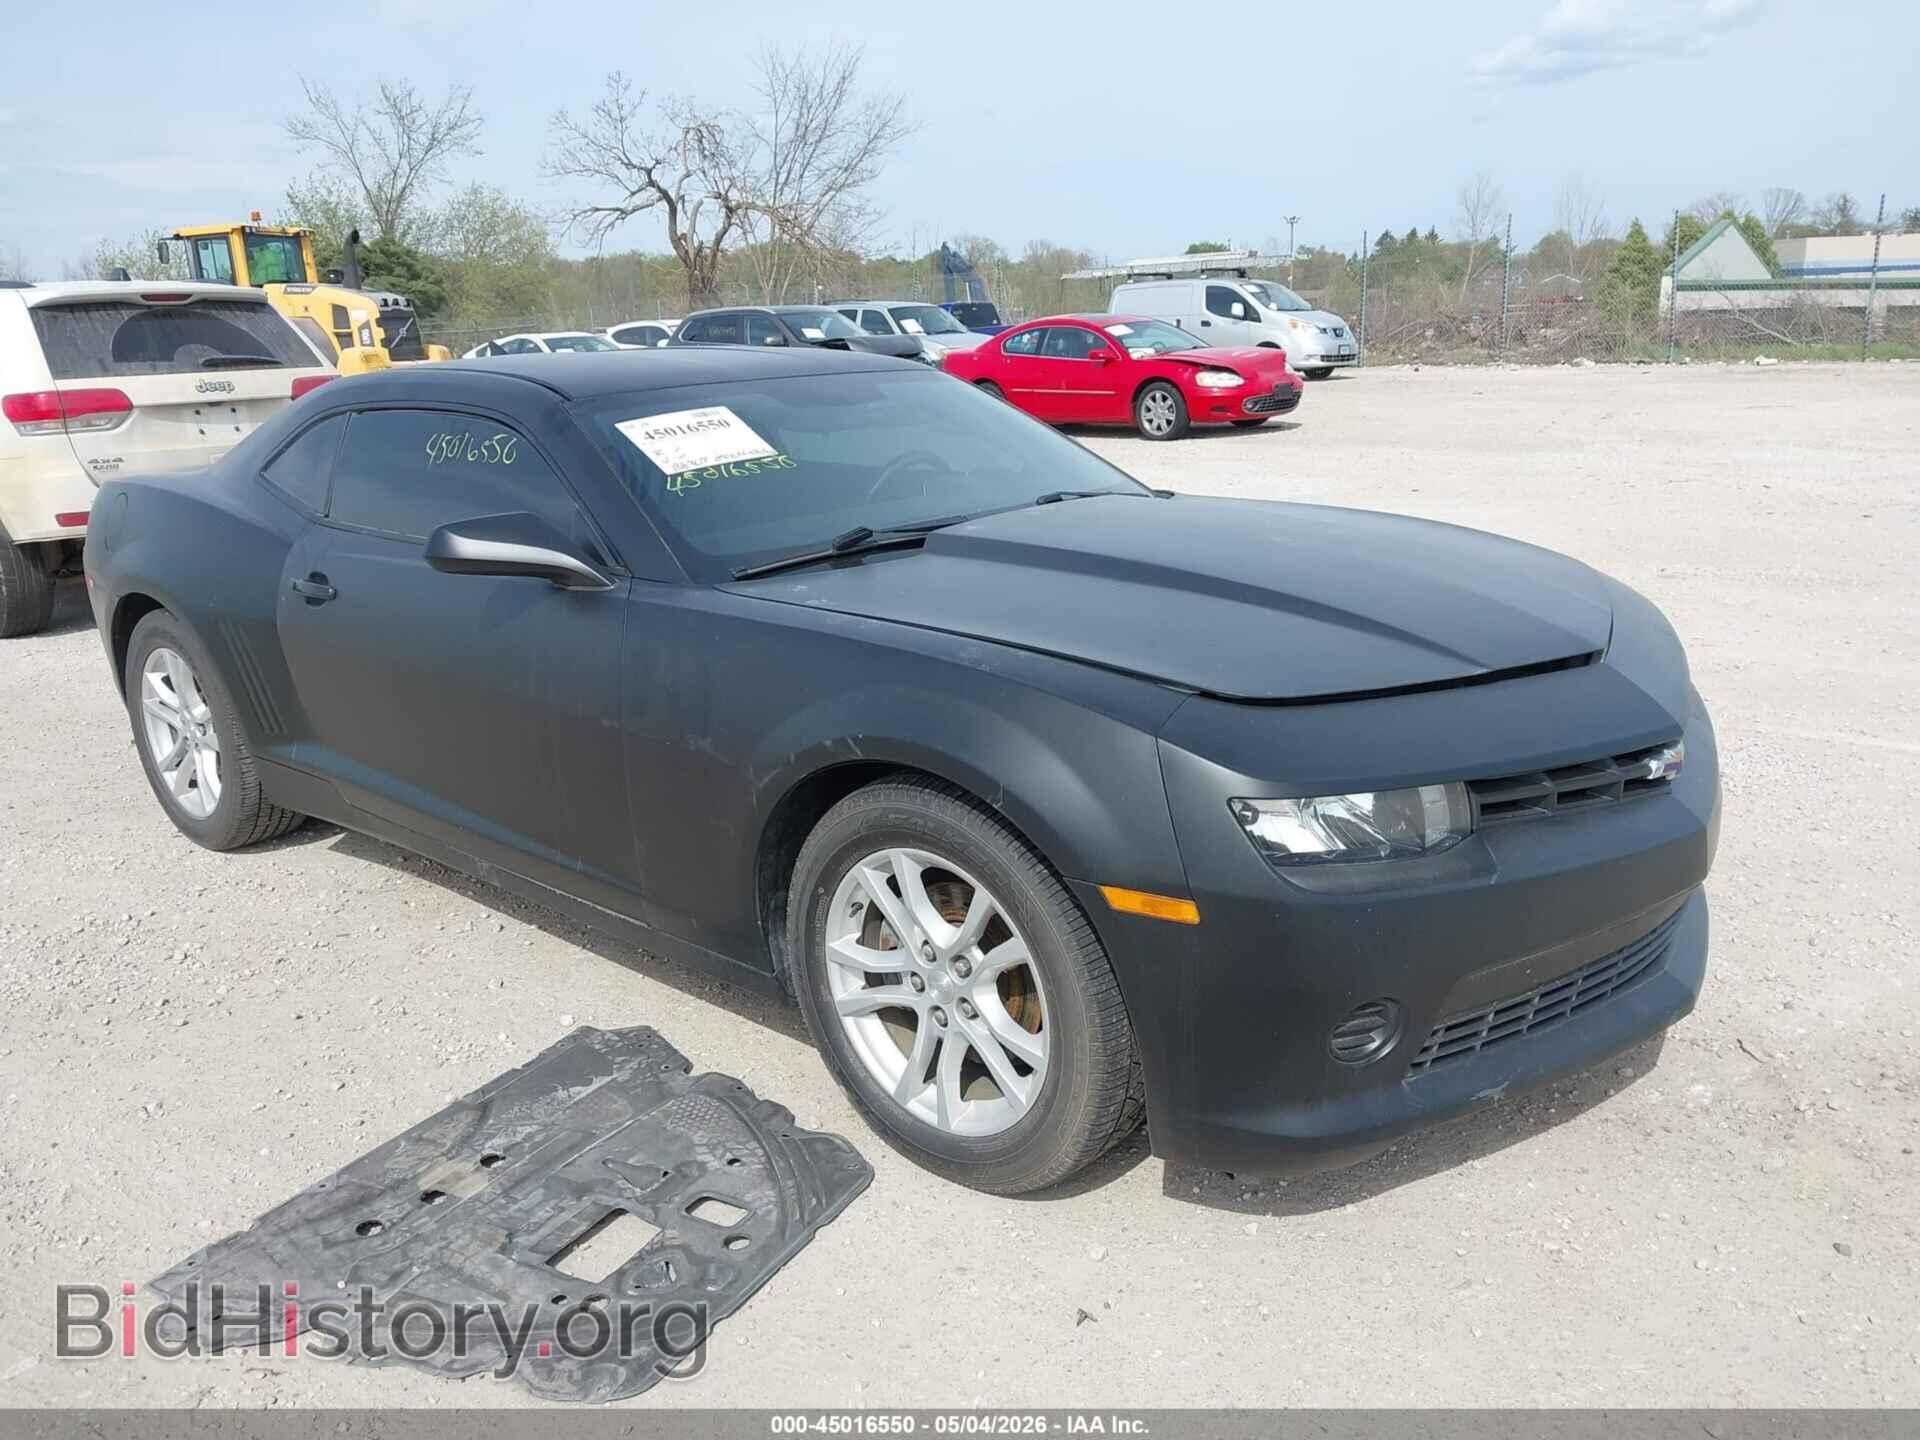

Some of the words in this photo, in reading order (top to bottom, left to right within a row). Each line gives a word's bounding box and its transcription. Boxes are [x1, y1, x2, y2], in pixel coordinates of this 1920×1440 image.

[195, 379, 236, 394] Jeep
[644, 418, 732, 441] 45016550
[426, 432, 518, 469] 45016550
